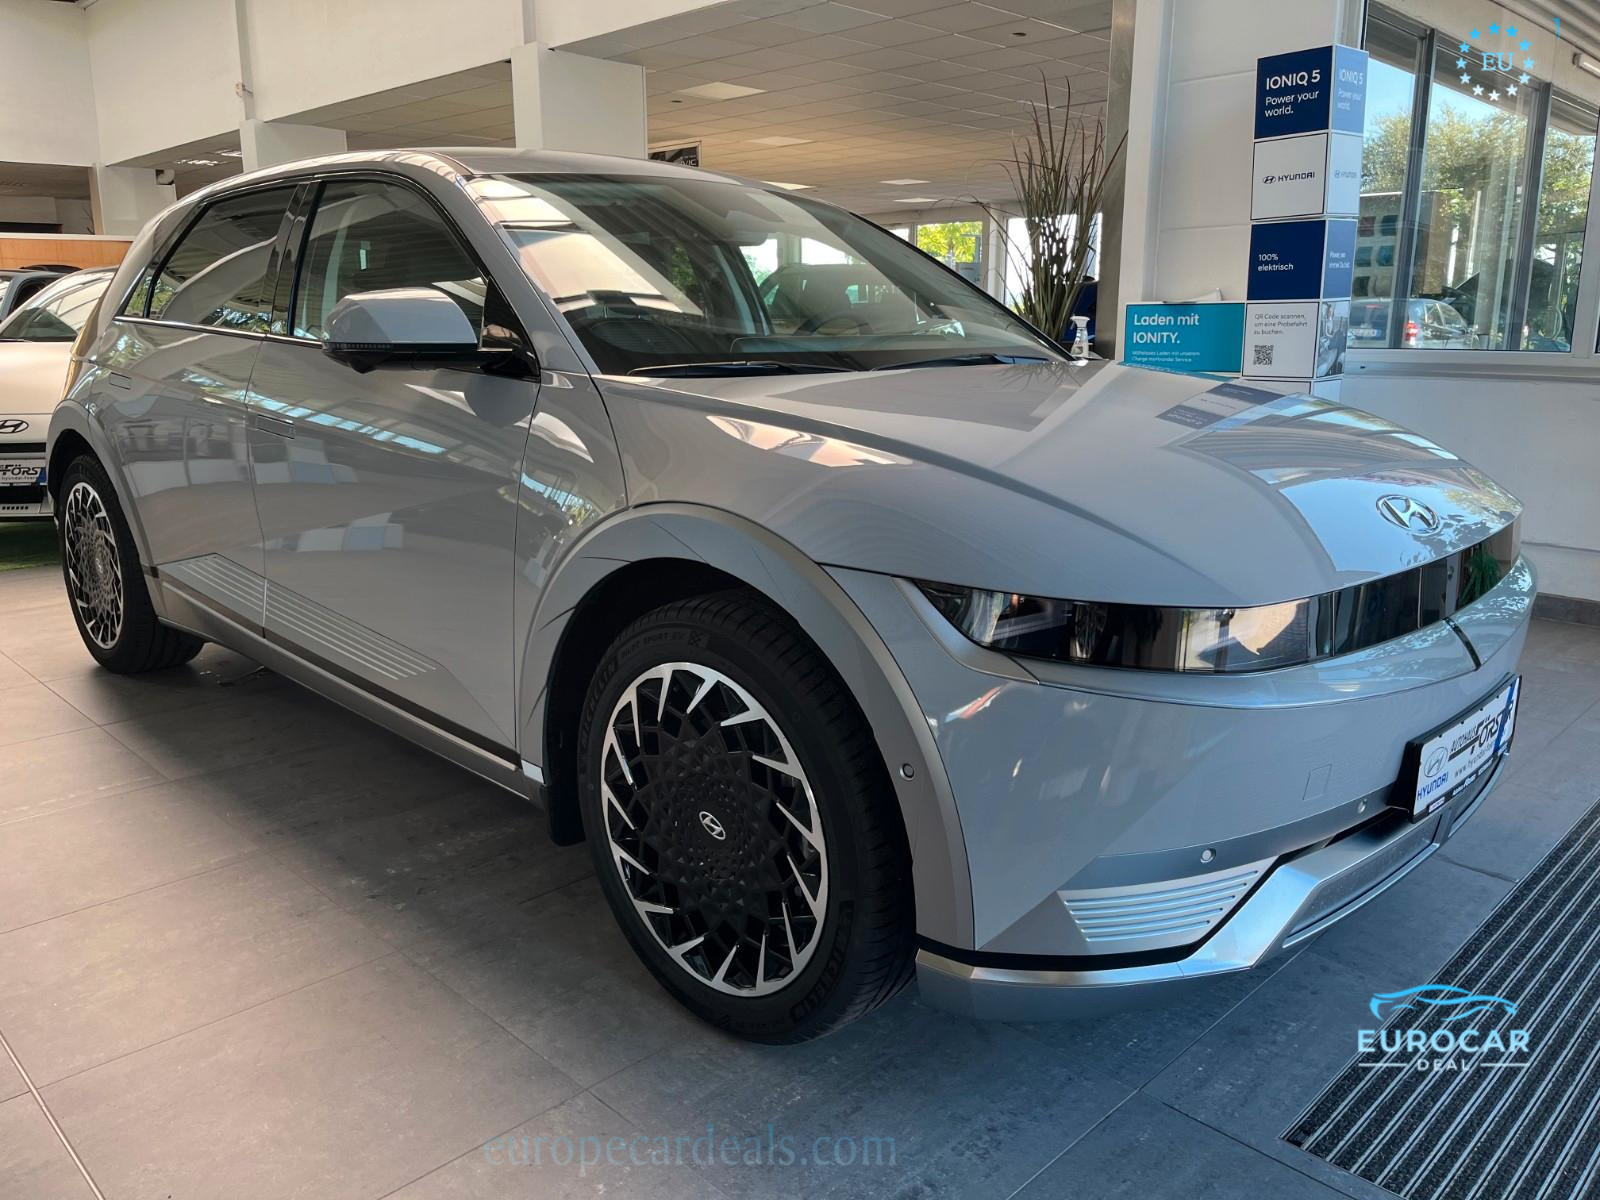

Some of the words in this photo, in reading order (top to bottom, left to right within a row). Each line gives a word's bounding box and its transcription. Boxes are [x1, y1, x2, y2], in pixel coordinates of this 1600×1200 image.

[1266, 72, 1308, 90] IONIQ
[1311, 69, 1320, 83] 5
[1265, 94, 1295, 106] Power
[1297, 90, 1320, 103] your
[1265, 105, 1294, 117] world.
[1277, 171, 1316, 182] HYUNDAI
[1258, 253, 1279, 262] 100%
[1257, 262, 1294, 272] elektrisch
[1134, 313, 1174, 326] Laden
[1177, 312, 1200, 326] mit
[1264, 312, 1280, 320] Code
[1132, 331, 1180, 344] IONITY.
[1417, 771, 1449, 801] HYUNDAI
